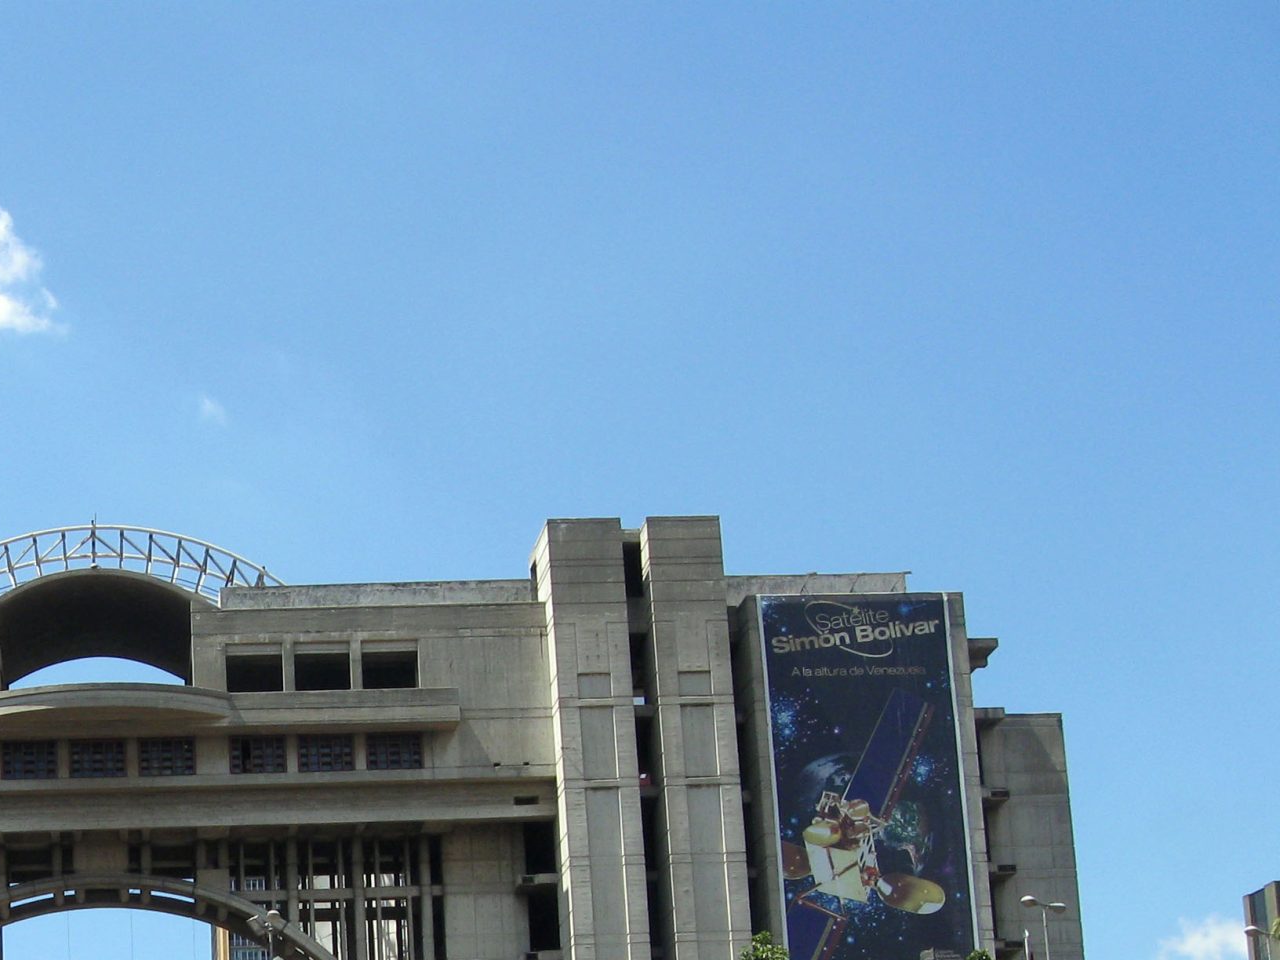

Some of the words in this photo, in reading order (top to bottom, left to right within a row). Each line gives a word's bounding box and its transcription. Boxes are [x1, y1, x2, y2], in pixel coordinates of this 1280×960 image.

[771, 630, 851, 654] Simón
[854, 619, 940, 644] Bolívar
[791, 667, 801, 676] A
[802, 666, 813, 677] la
[815, 666, 848, 677] altura
[849, 666, 864, 676] de
